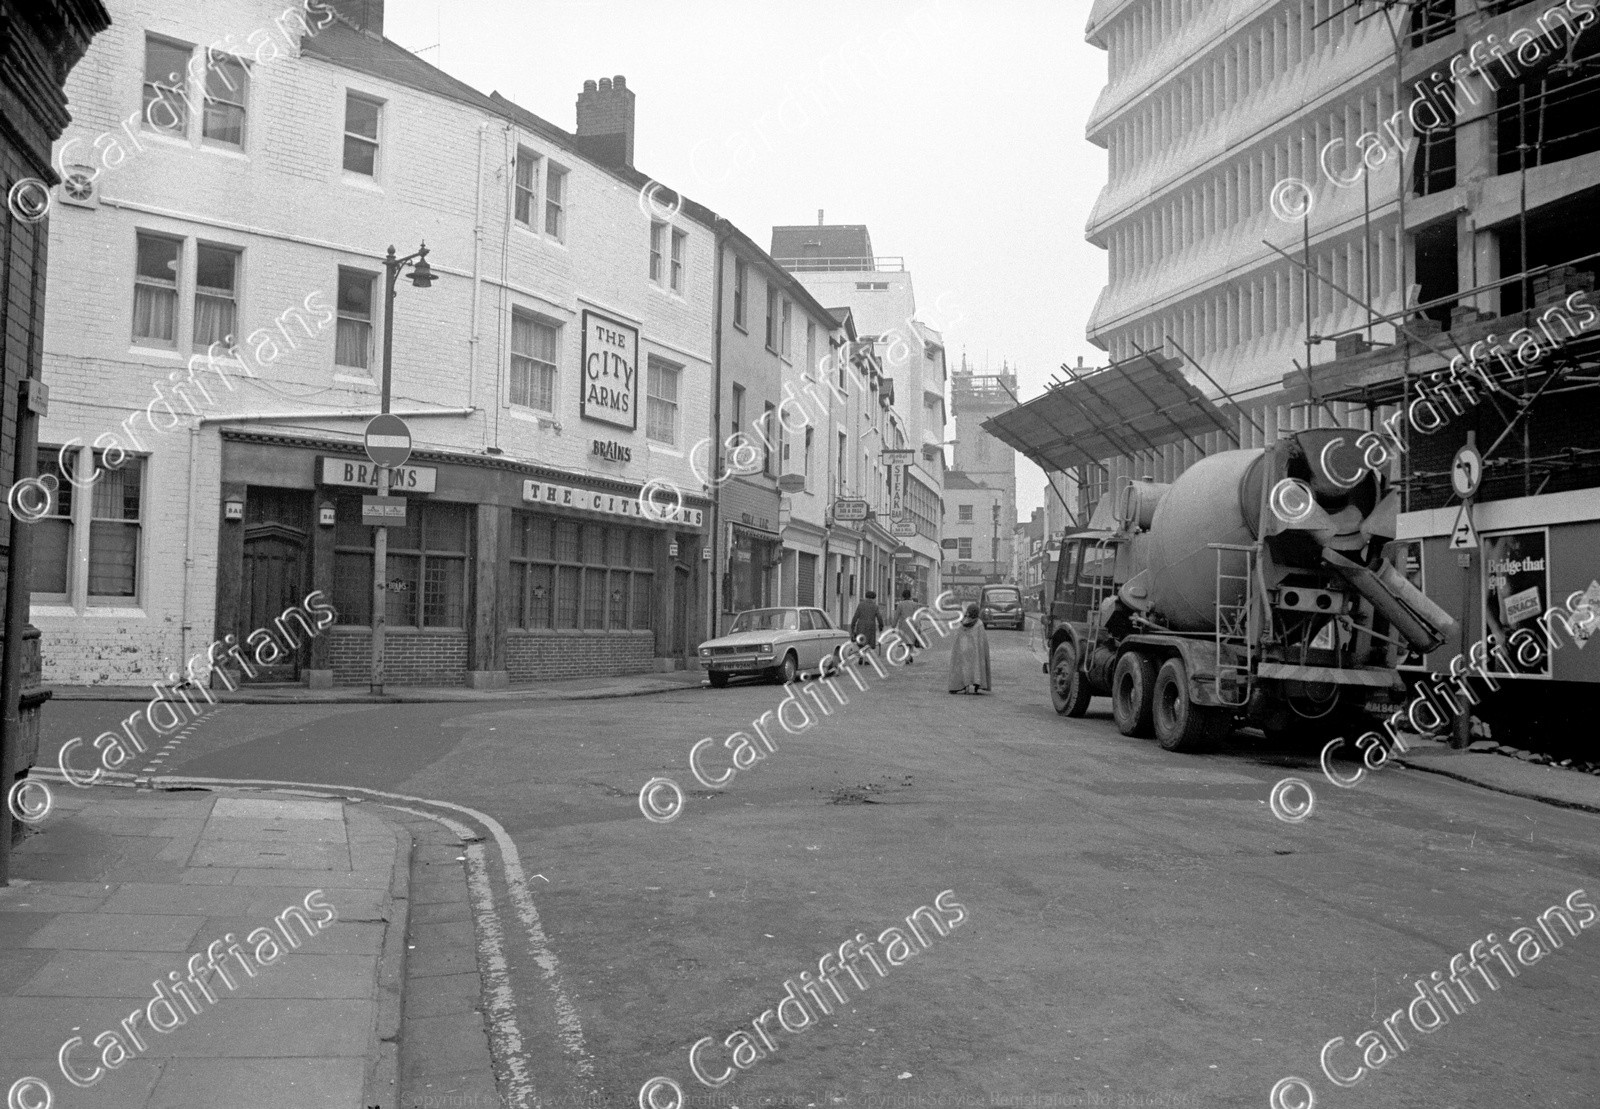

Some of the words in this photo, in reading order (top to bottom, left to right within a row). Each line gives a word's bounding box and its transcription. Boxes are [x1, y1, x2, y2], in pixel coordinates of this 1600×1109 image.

[596, 325, 626, 348] THE
[587, 350, 633, 391] CITY
[587, 384, 629, 412] ARMS
[593, 439, 632, 462] BRAINS
[343, 463, 417, 487] BRANS
[893, 465, 901, 508] STEAK
[531, 483, 572, 504] THE
[593, 495, 640, 515] CITY
[1488, 557, 1521, 575] Bridge
[1522, 556, 1545, 571] that
[1488, 576, 1507, 589] gap
[1507, 597, 1538, 615] SNACK
